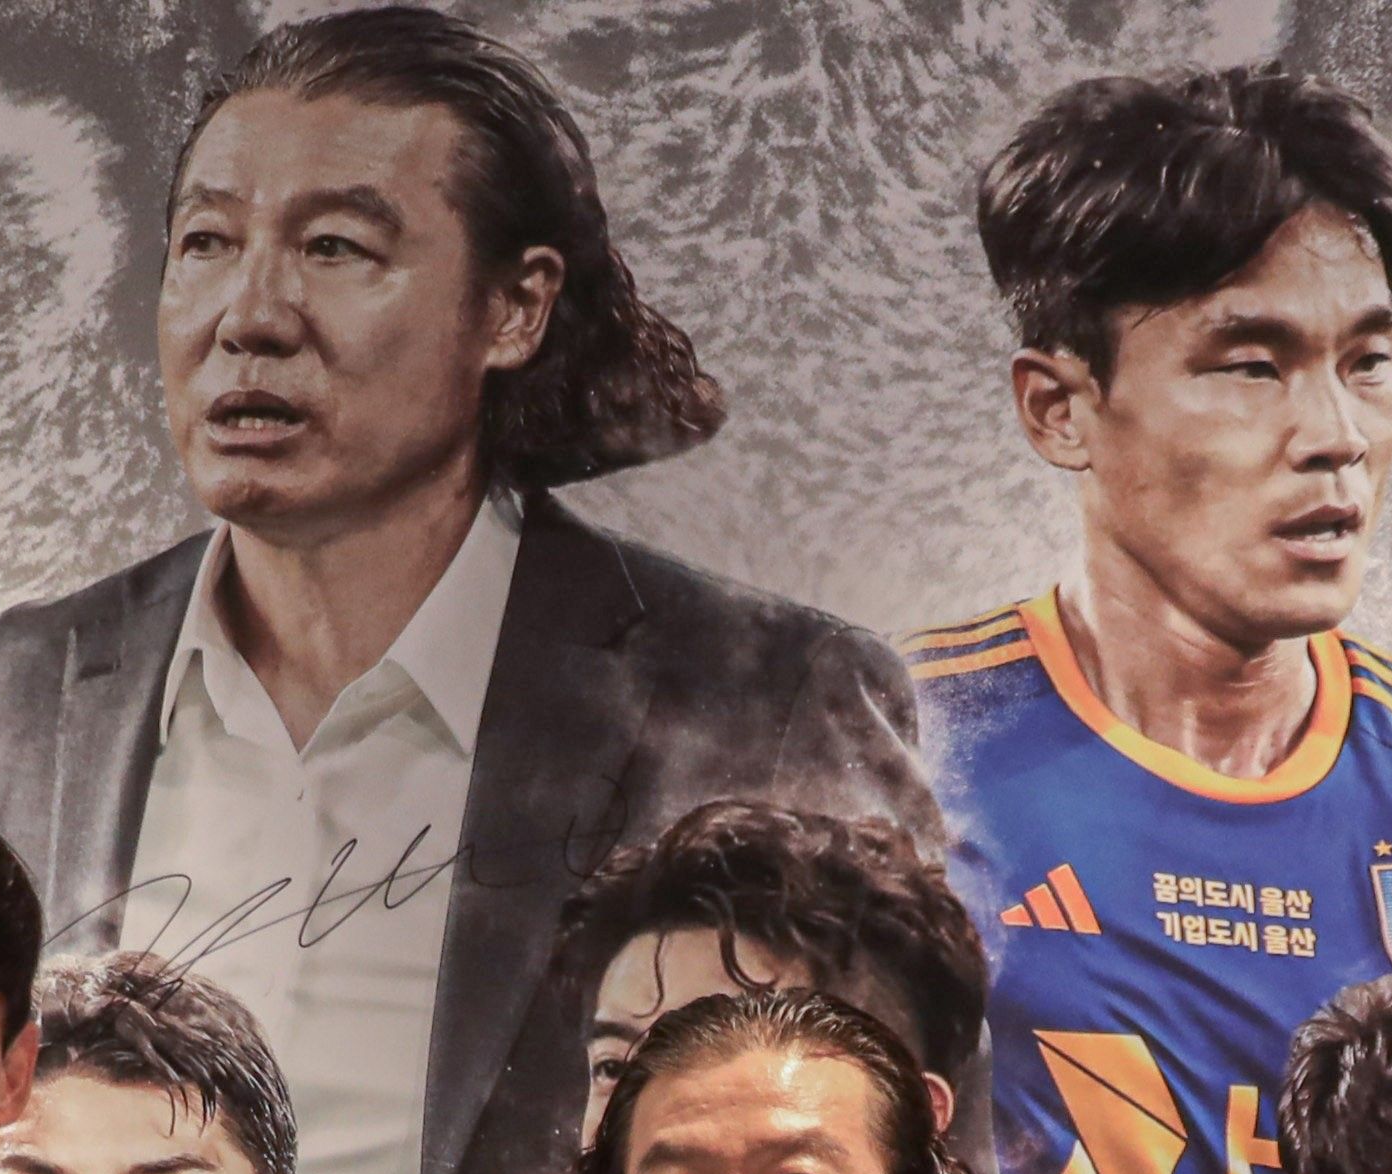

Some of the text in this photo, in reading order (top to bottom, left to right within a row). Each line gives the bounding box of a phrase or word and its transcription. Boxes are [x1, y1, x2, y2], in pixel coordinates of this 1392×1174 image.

[1153, 872, 1312, 919] 꿈의도시 울산
[1156, 911, 1317, 957] 기업도시 울산
